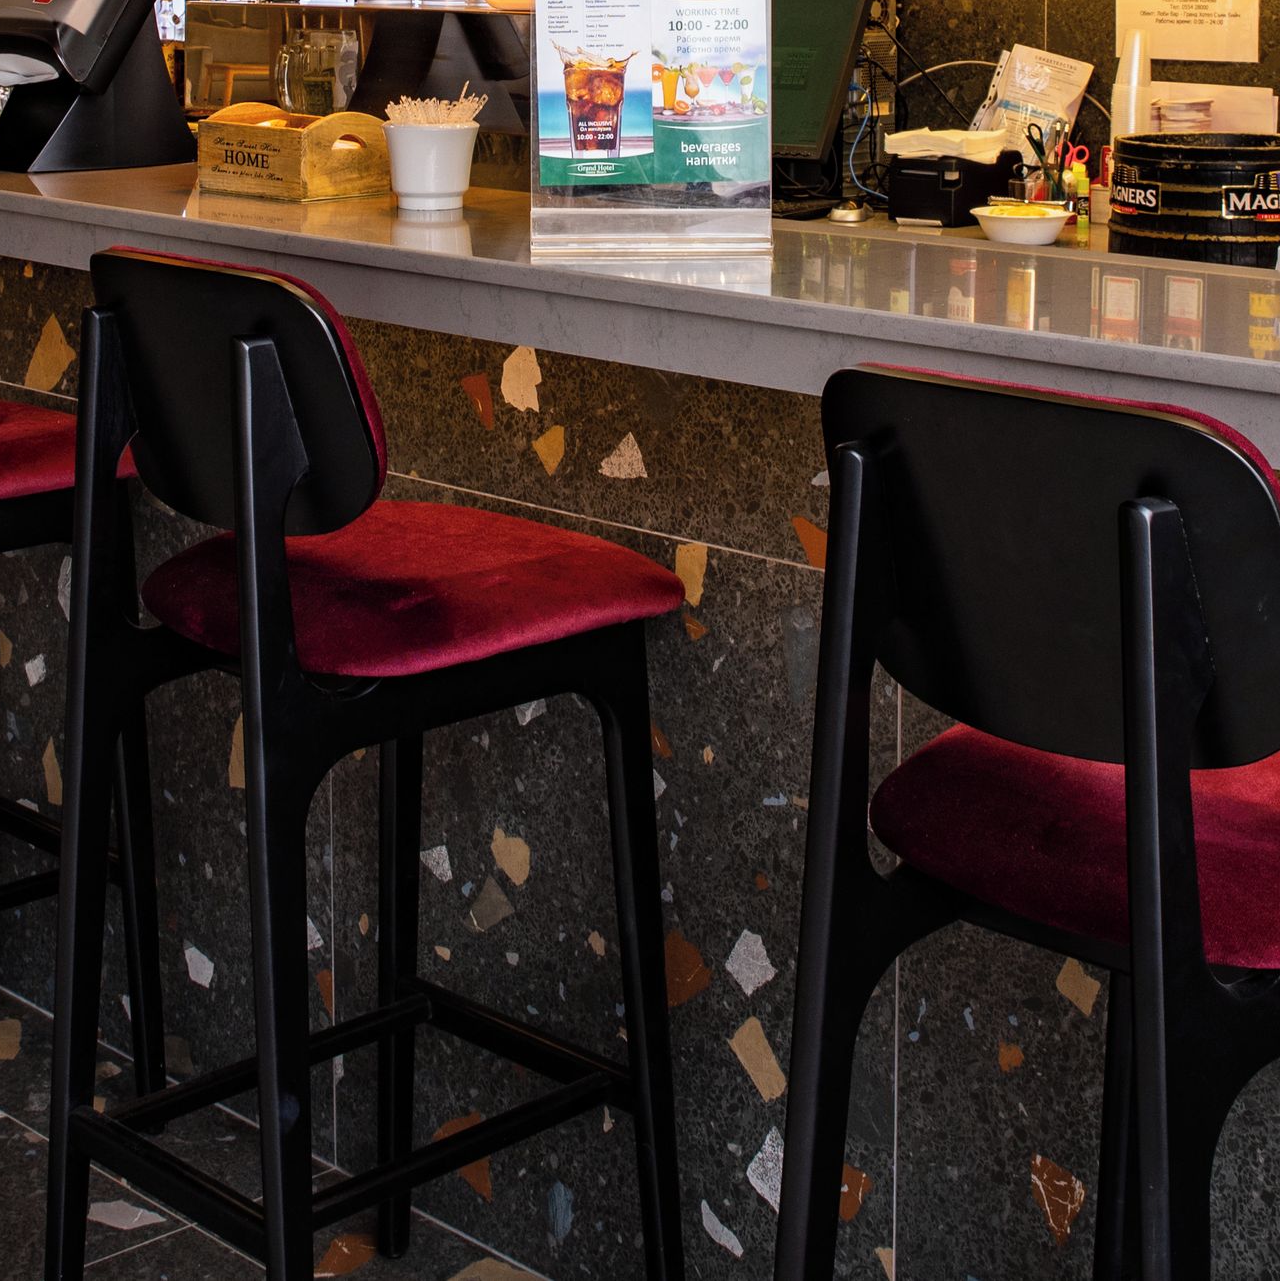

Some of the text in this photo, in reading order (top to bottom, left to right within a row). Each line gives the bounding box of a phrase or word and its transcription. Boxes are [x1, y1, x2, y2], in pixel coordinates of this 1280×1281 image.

[675, 7, 741, 17] WORKING TIME
[668, 19, 749, 32] 10:00 22:00
[676, 35, 741, 45] Рабочее время
[676, 46, 741, 55] Работно време
[681, 141, 741, 154] beverages
[224, 149, 270, 170] HOME
[686, 156, 737, 166] напитки
[1111, 187, 1157, 207] AGNERS
